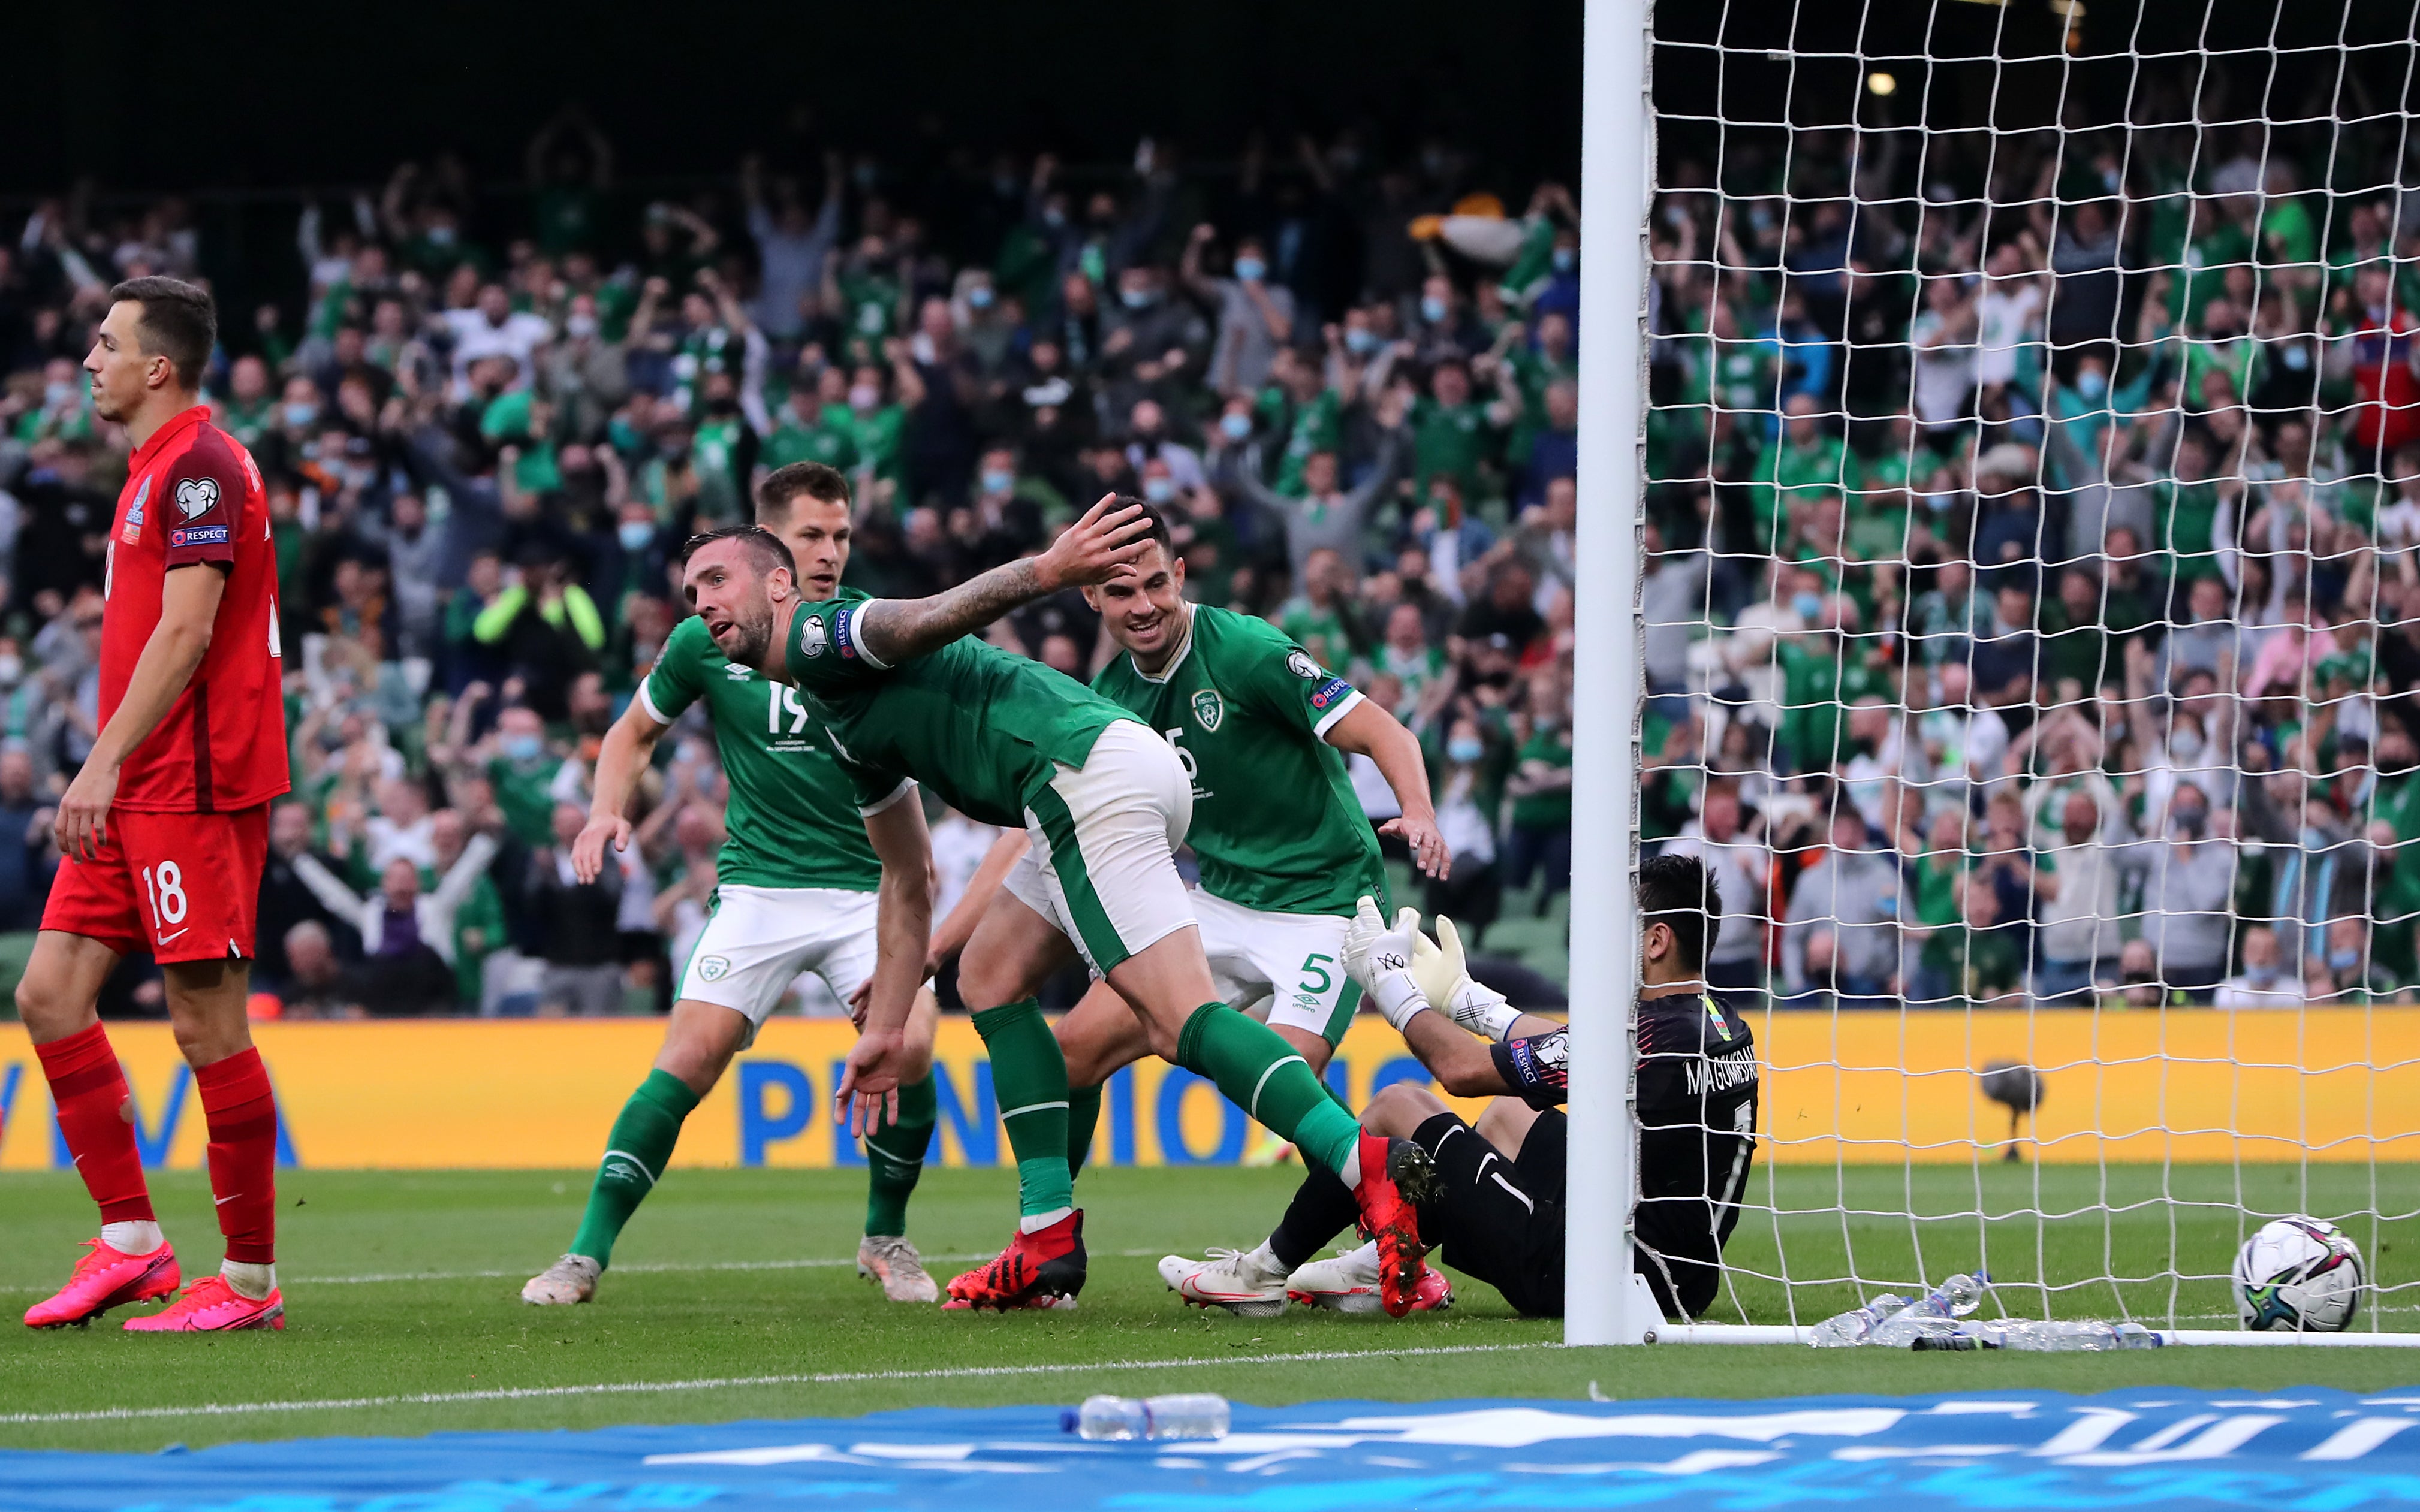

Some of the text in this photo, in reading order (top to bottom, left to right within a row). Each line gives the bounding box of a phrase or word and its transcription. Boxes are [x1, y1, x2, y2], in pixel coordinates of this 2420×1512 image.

[186, 529, 228, 541] RESPECT
[769, 680, 809, 734] 19
[142, 860, 187, 929] 18
[1298, 953, 1334, 994] 5
[1292, 1003, 1316, 1013] umbro
[1516, 1048, 1537, 1083] RESPECT
[1709, 1100, 1753, 1235] 1
